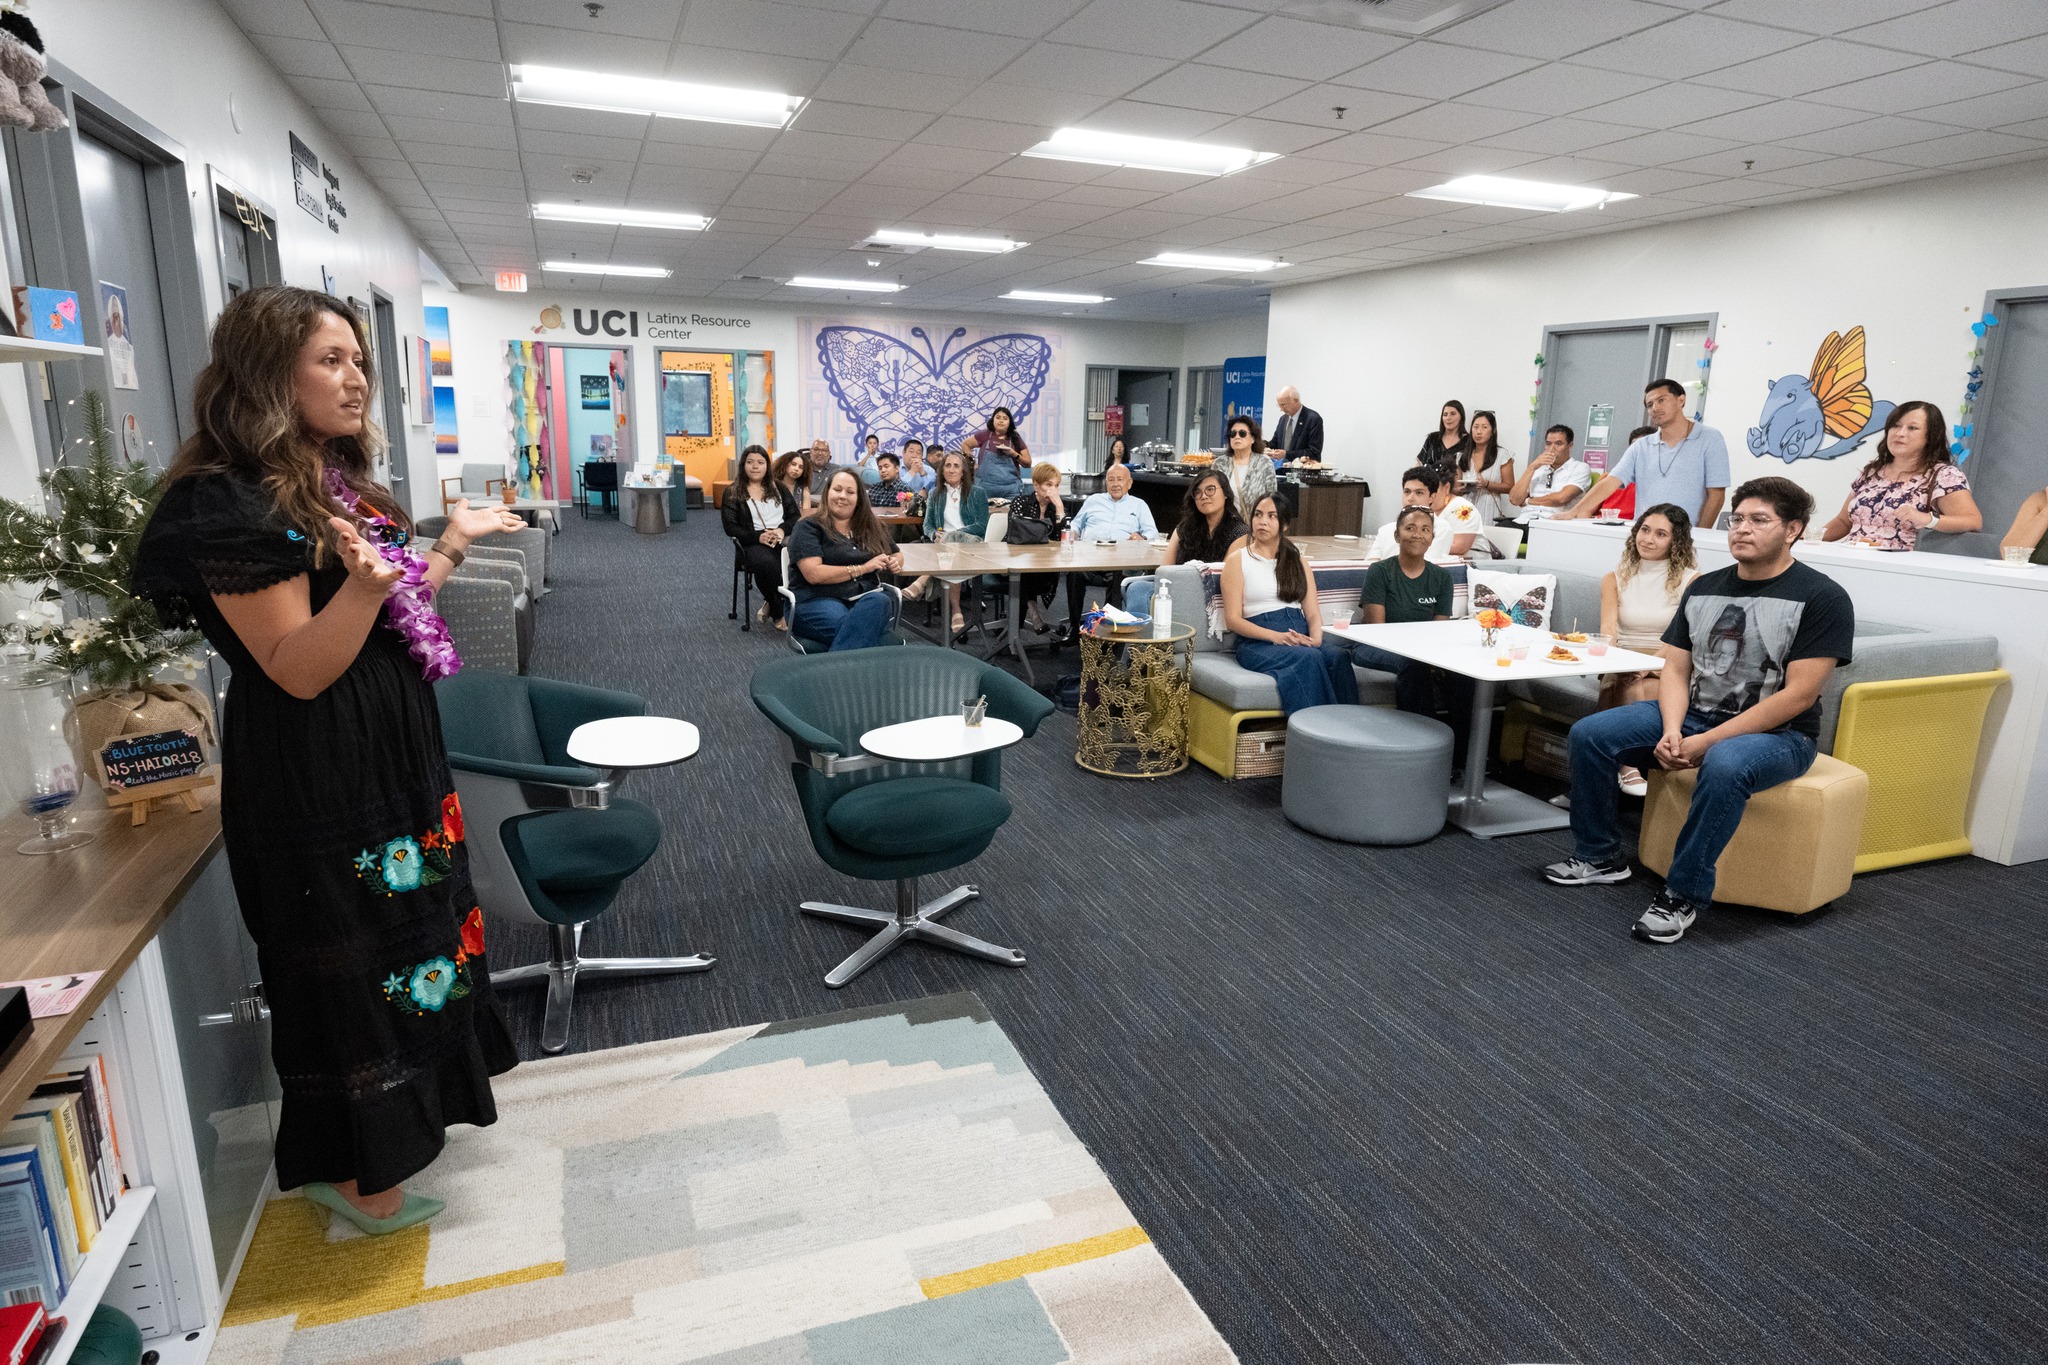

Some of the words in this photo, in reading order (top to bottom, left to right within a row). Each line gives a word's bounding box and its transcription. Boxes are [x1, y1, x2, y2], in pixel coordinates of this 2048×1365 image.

[500, 272, 523, 291] EXIT
[573, 308, 639, 338] UCI
[647, 312, 688, 325] Latinx
[691, 314, 751, 328] Resource
[647, 327, 692, 340] Center
[1226, 371, 1240, 384] UCI
[1239, 406, 1254, 417] UCI
[112, 738, 188, 760] BLUETOOTH
[145, 773, 159, 782] the
[179, 767, 194, 777] play
